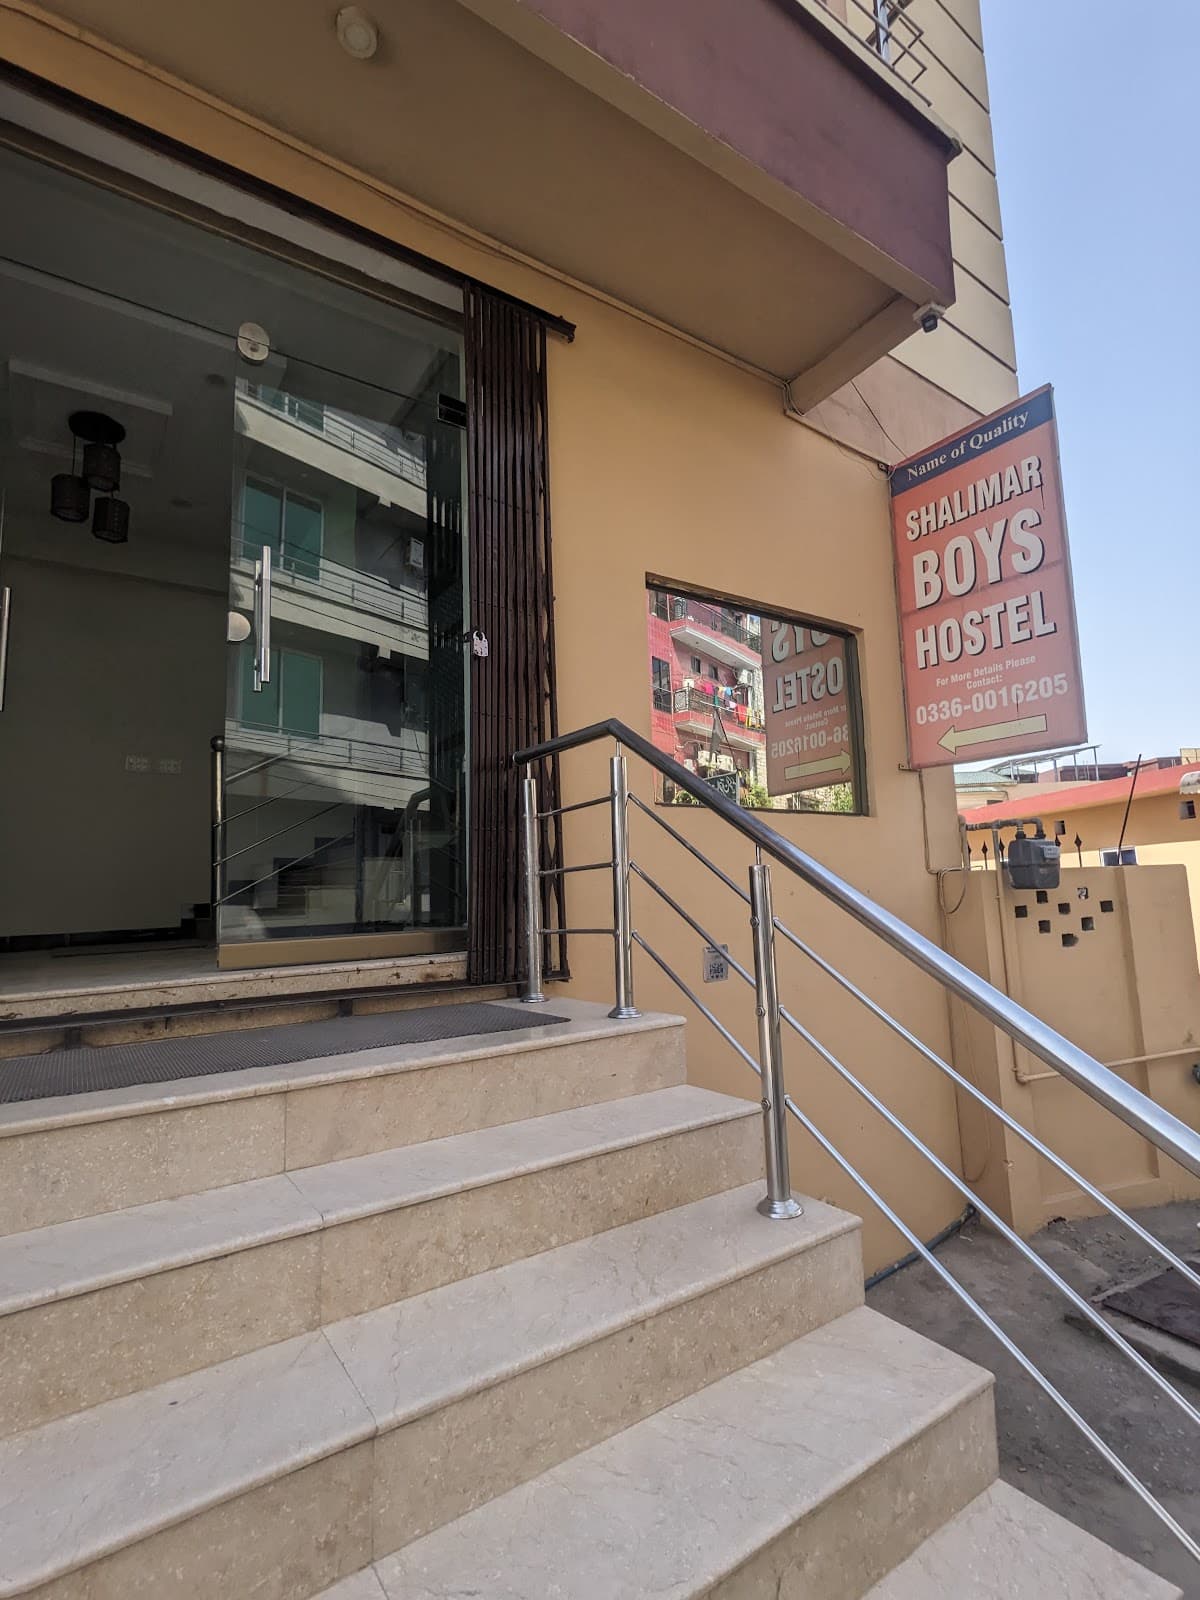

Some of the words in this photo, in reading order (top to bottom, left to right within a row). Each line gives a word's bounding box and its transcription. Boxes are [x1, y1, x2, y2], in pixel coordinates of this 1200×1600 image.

[907, 454, 947, 481] Name
[950, 440, 967, 459] of
[969, 411, 1029, 449] Quality
[905, 455, 1043, 541] SHALIMAR
[912, 508, 1045, 610] BOYS
[915, 590, 1057, 670] HOSTEL
[916, 672, 1068, 725] 0336-0016205
[936, 677, 949, 688] For
[950, 671, 971, 684] More
[973, 663, 1003, 676] Details
[1005, 655, 1036, 670] Please
[966, 674, 1003, 690] Contact:
